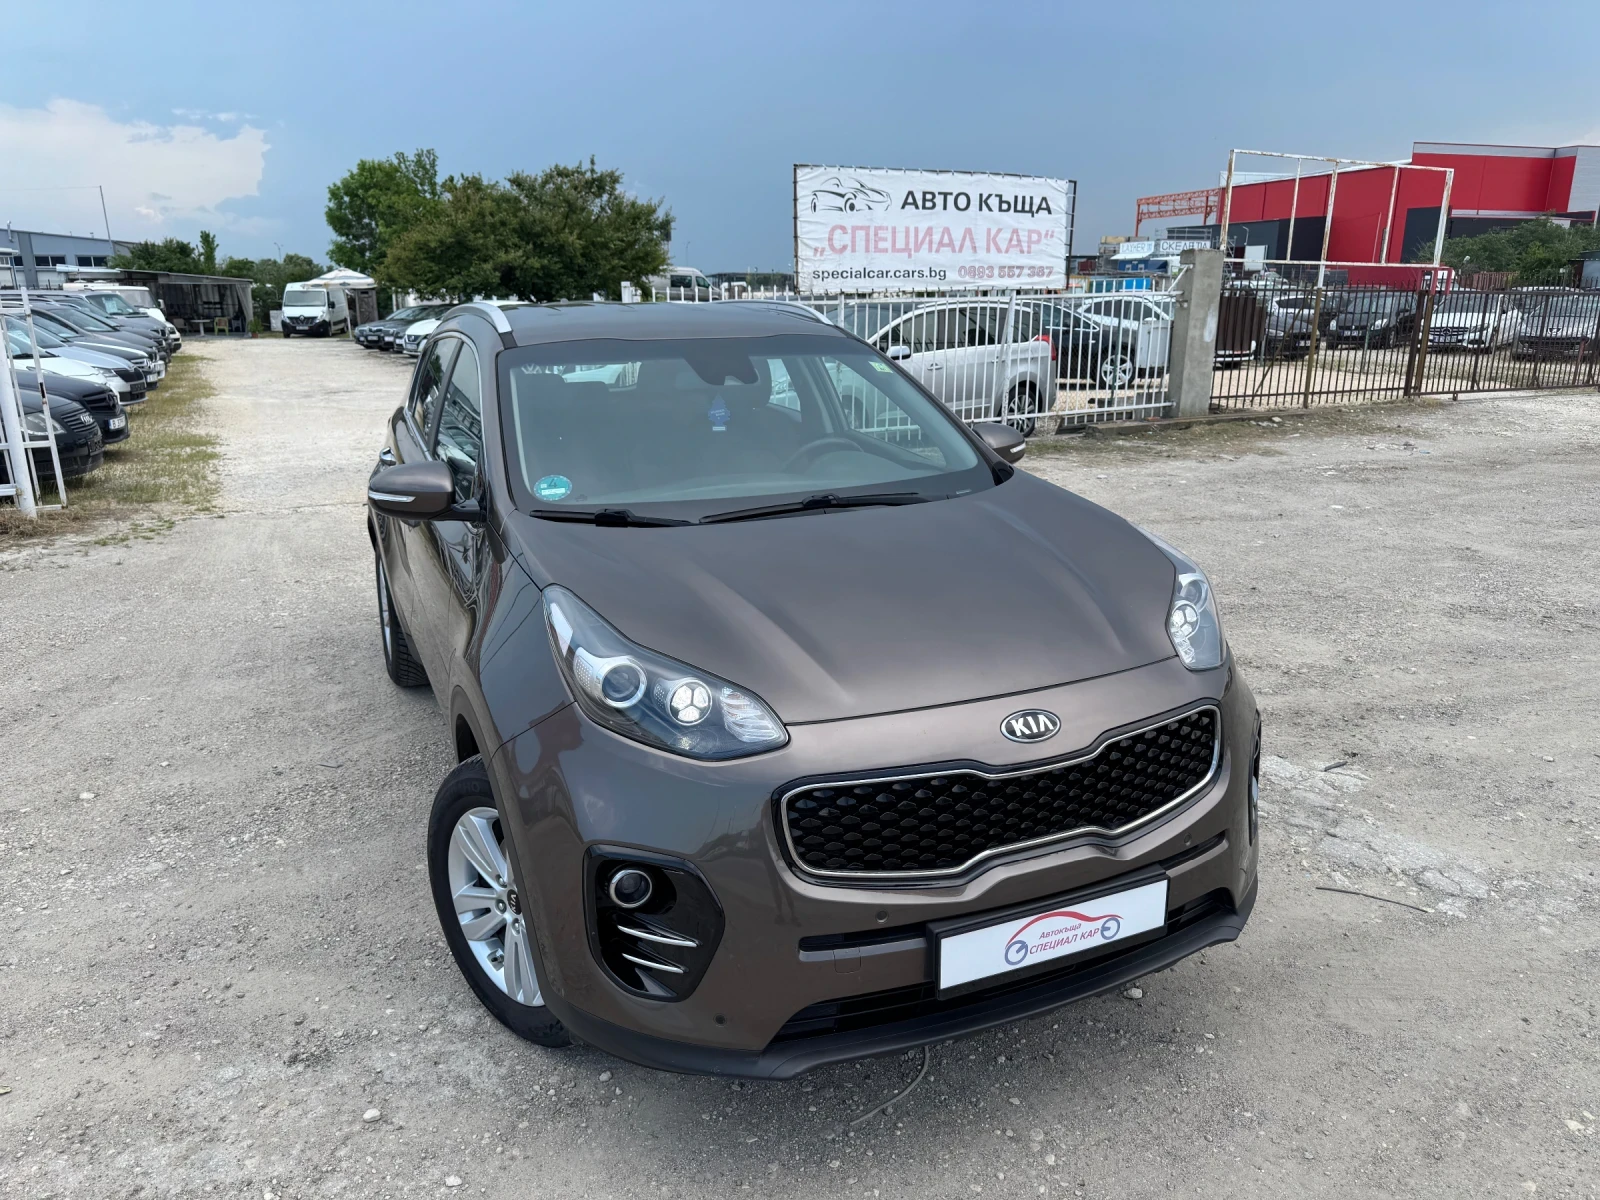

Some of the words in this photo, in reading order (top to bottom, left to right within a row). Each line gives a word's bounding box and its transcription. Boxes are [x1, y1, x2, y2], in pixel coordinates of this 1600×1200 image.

[901, 190, 971, 211] АВТО
[978, 193, 1052, 217] КЪЩА
[813, 224, 977, 258] „СПЕЦИАЛ
[812, 267, 947, 282] specialcar.cars.bg
[958, 265, 995, 279] 0893
[998, 265, 1025, 279] 557
[1027, 265, 1054, 279] 367
[1009, 714, 1055, 737] KIA
[1029, 933, 1079, 955] СПЕЦИАЛ
[1080, 927, 1101, 943] КАР
[1038, 922, 1083, 940] Автокъща
